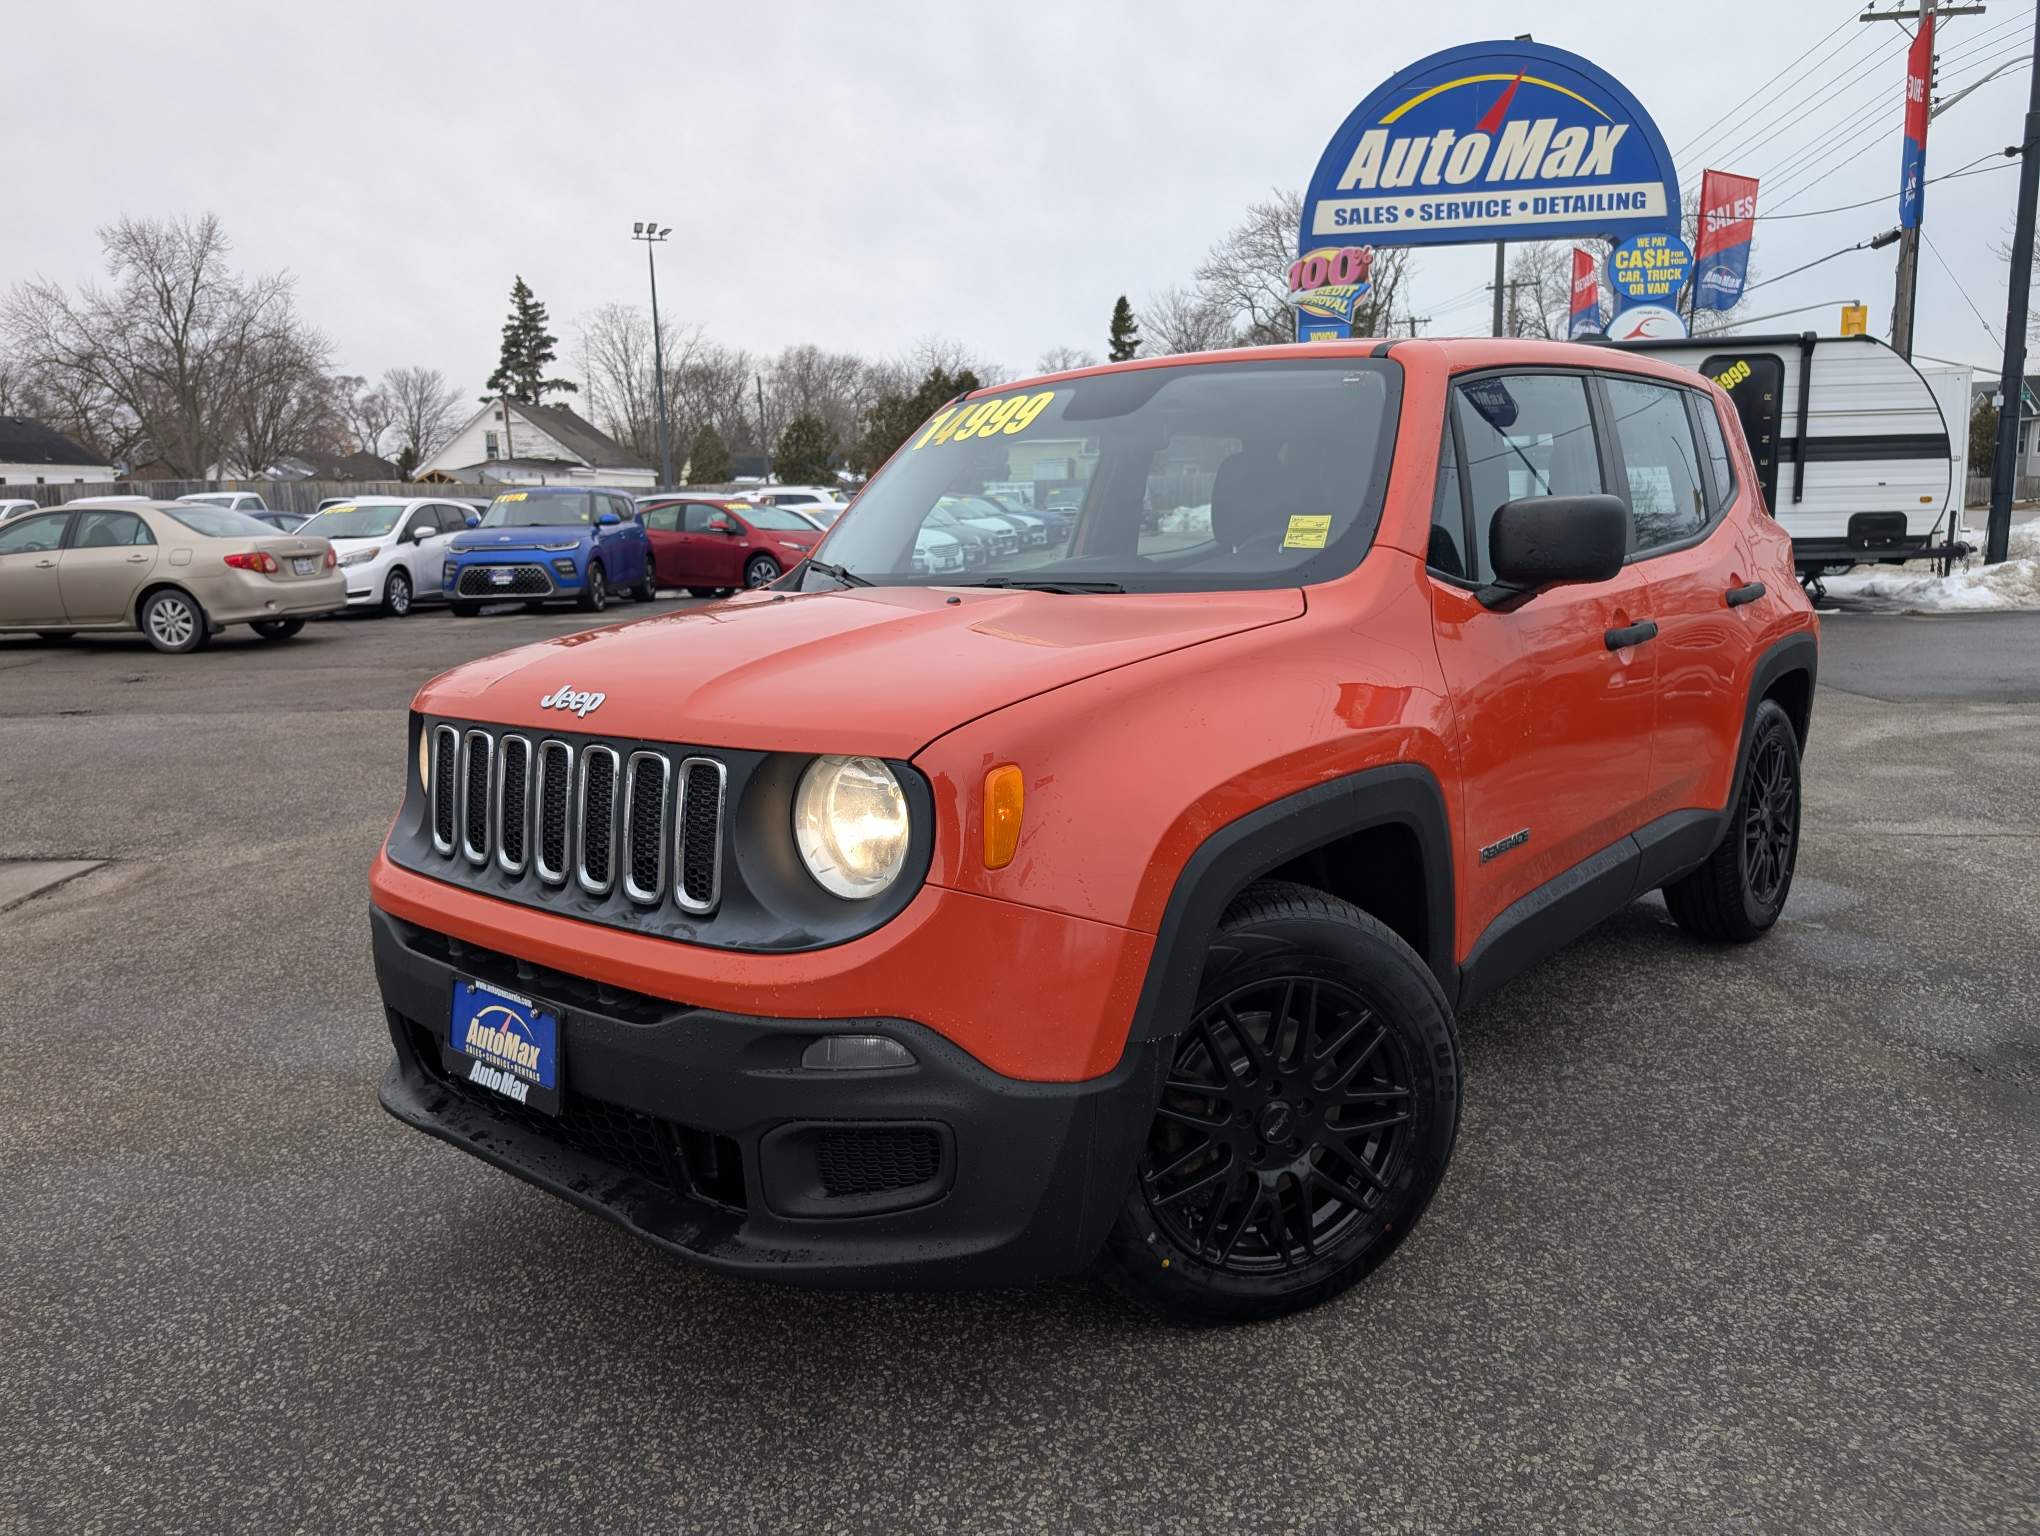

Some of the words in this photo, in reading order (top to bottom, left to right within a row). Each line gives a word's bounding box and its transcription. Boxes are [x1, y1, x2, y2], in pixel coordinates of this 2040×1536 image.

[1334, 205, 1399, 227] SALES
[1419, 199, 1512, 222] SERVICE
[1532, 191, 1647, 215] DETAILING
[1706, 195, 1754, 233] SALES
[1615, 248, 1671, 269] CA$H
[1637, 238, 1649, 248] WE
[1652, 236, 1667, 247] PAY
[1287, 245, 1374, 294] 100%
[1618, 271, 1644, 283] CAR,
[1647, 268, 1682, 281] TRUCK
[1670, 257, 1688, 265] YOUR
[1629, 284, 1645, 295] OR
[1647, 282, 1669, 294] VAN
[912, 391, 1056, 451] 14999
[541, 685, 606, 718] Jeep
[466, 1017, 541, 1070] AutoMax
[466, 1044, 482, 1058] SALES
[486, 1052, 511, 1070] SERVICE
[515, 1063, 541, 1082] RENTALS
[469, 1060, 530, 1103] AutoMax
